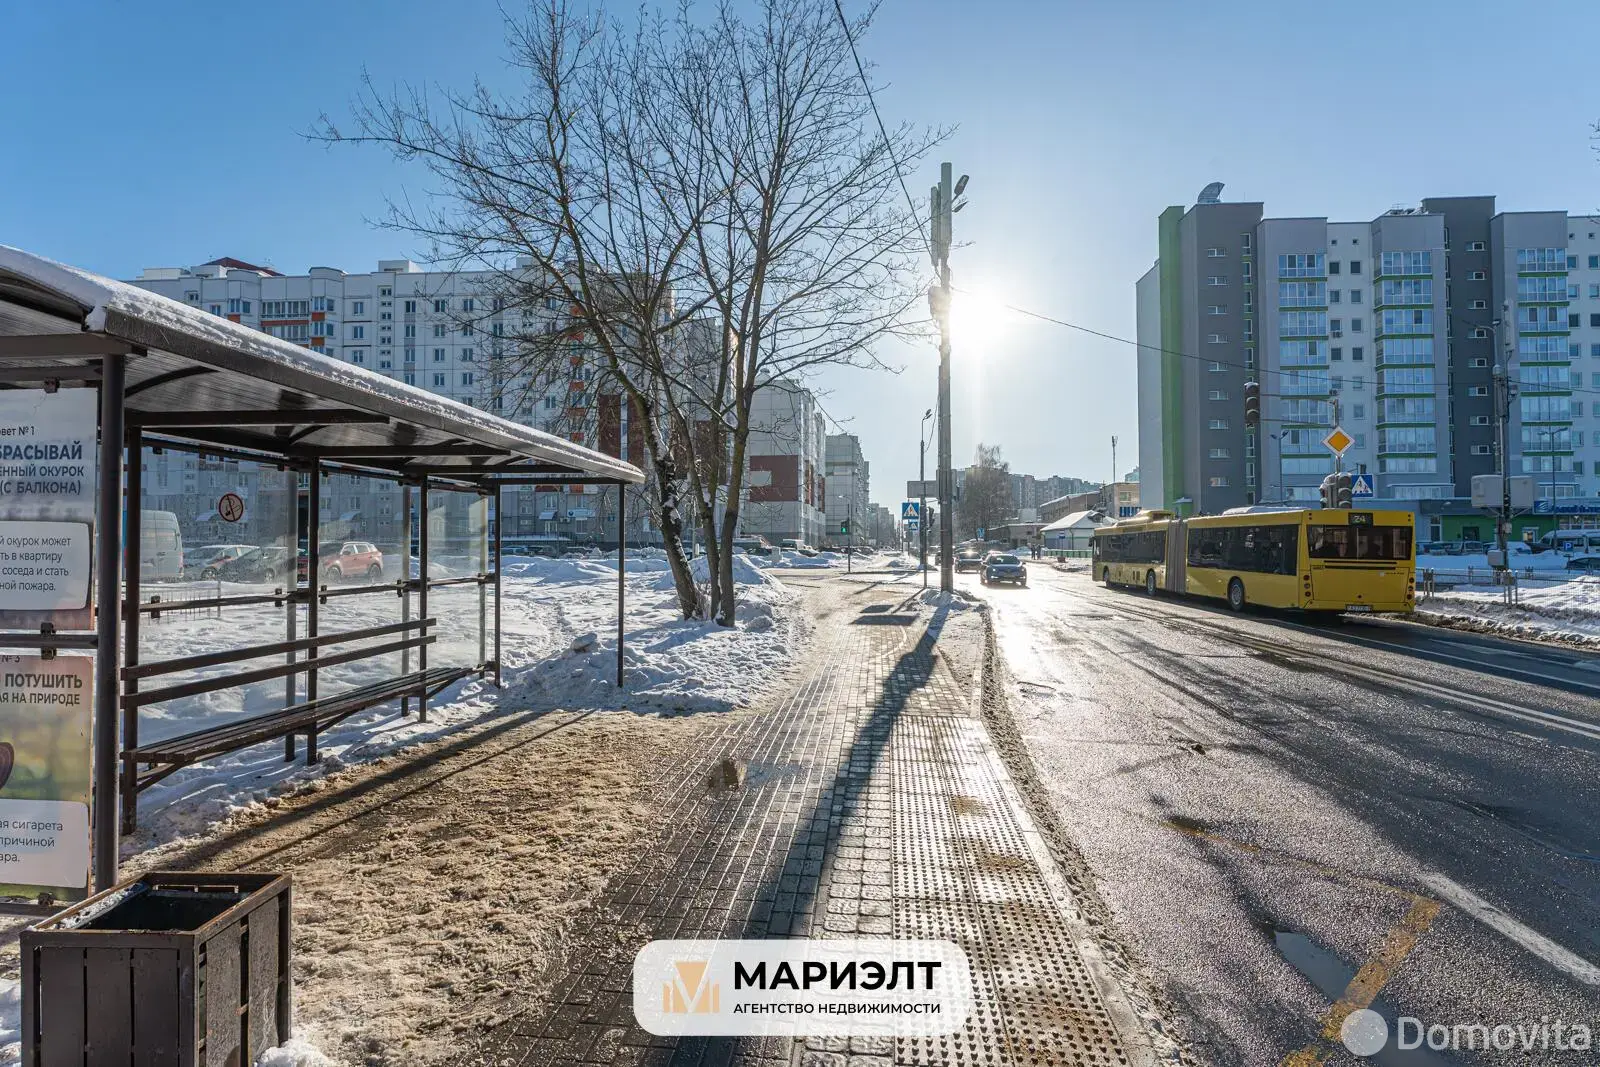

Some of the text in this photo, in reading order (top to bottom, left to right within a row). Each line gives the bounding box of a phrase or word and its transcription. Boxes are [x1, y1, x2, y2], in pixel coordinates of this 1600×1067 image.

[0, 426, 35, 436] вет № 1
[0, 440, 82, 460] РАСЫВАЙ
[39, 466, 85, 477] ОКУРОК
[1, 480, 81, 496] (С БАЛКОНА)
[6, 537, 40, 548] окурок
[41, 537, 72, 546] может
[11, 552, 17, 561] в
[19, 552, 63, 564] квартиру
[2, 567, 70, 577] соседа и стать
[19, 582, 56, 592] пожара.
[4, 673, 83, 689] ПОТУШИТЬ
[11, 692, 27, 704] НА
[29, 693, 81, 706] ПРИРОДЕ
[12, 820, 64, 832] сигарета
